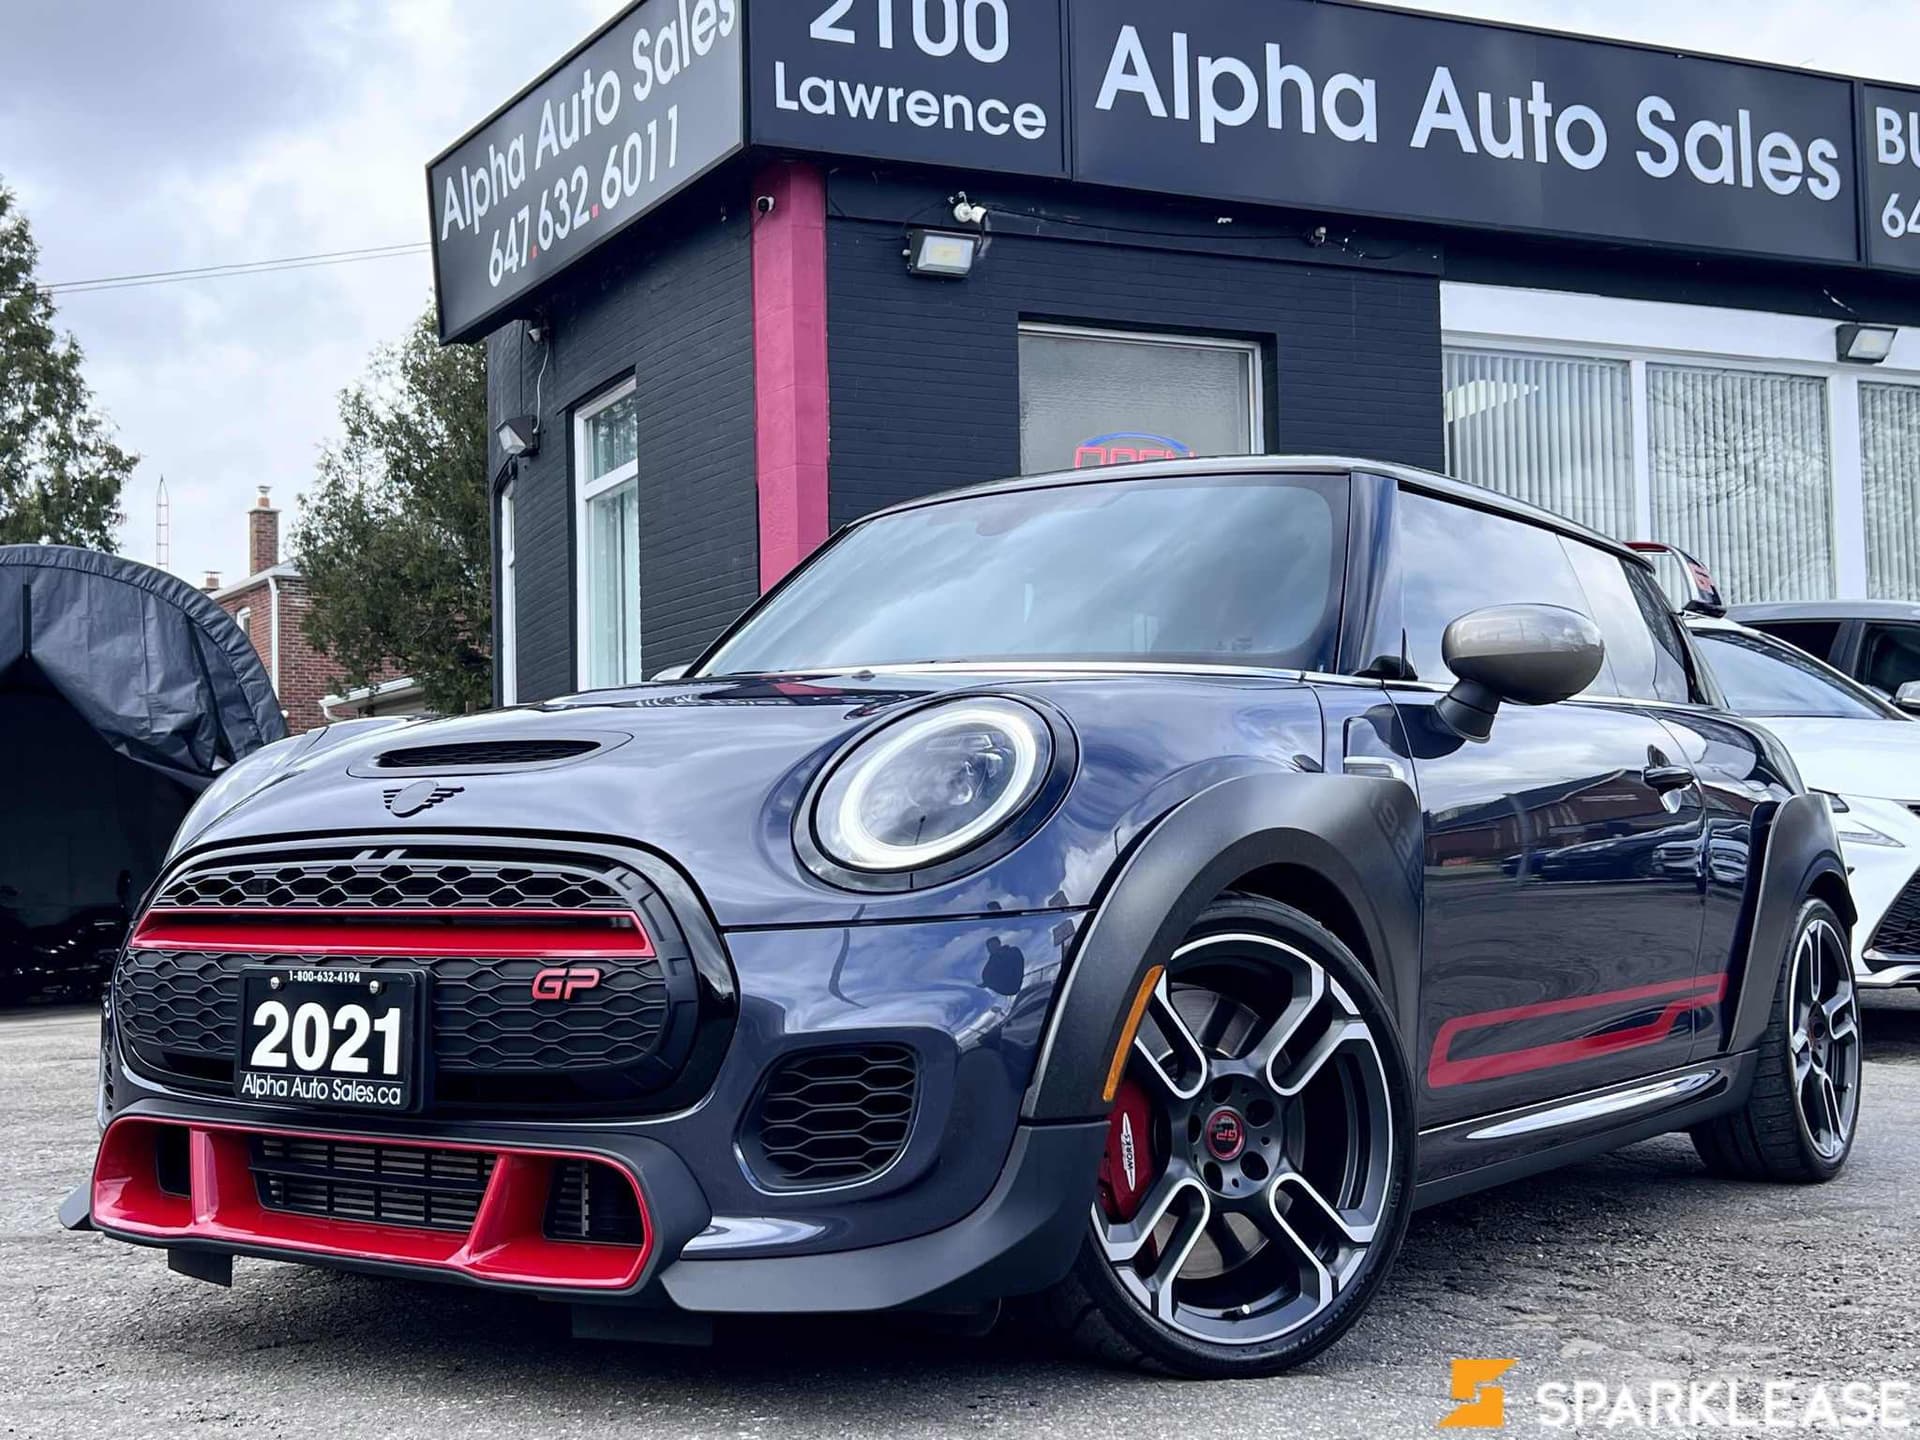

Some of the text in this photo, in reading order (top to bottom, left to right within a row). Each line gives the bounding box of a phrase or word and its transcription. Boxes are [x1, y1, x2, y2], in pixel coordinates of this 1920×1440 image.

[442, 0, 736, 241] Alpha Auto Sales
[774, 61, 1047, 140] Lawrence
[1094, 25, 1842, 201] Alpha Auto Sales
[488, 103, 678, 288] 647.632.6011
[288, 970, 361, 983] 1-800-632-4194
[532, 968, 600, 1000] GP
[250, 1000, 401, 1075] 2021
[241, 1073, 401, 1105] Alpha Auto Sales.ca
